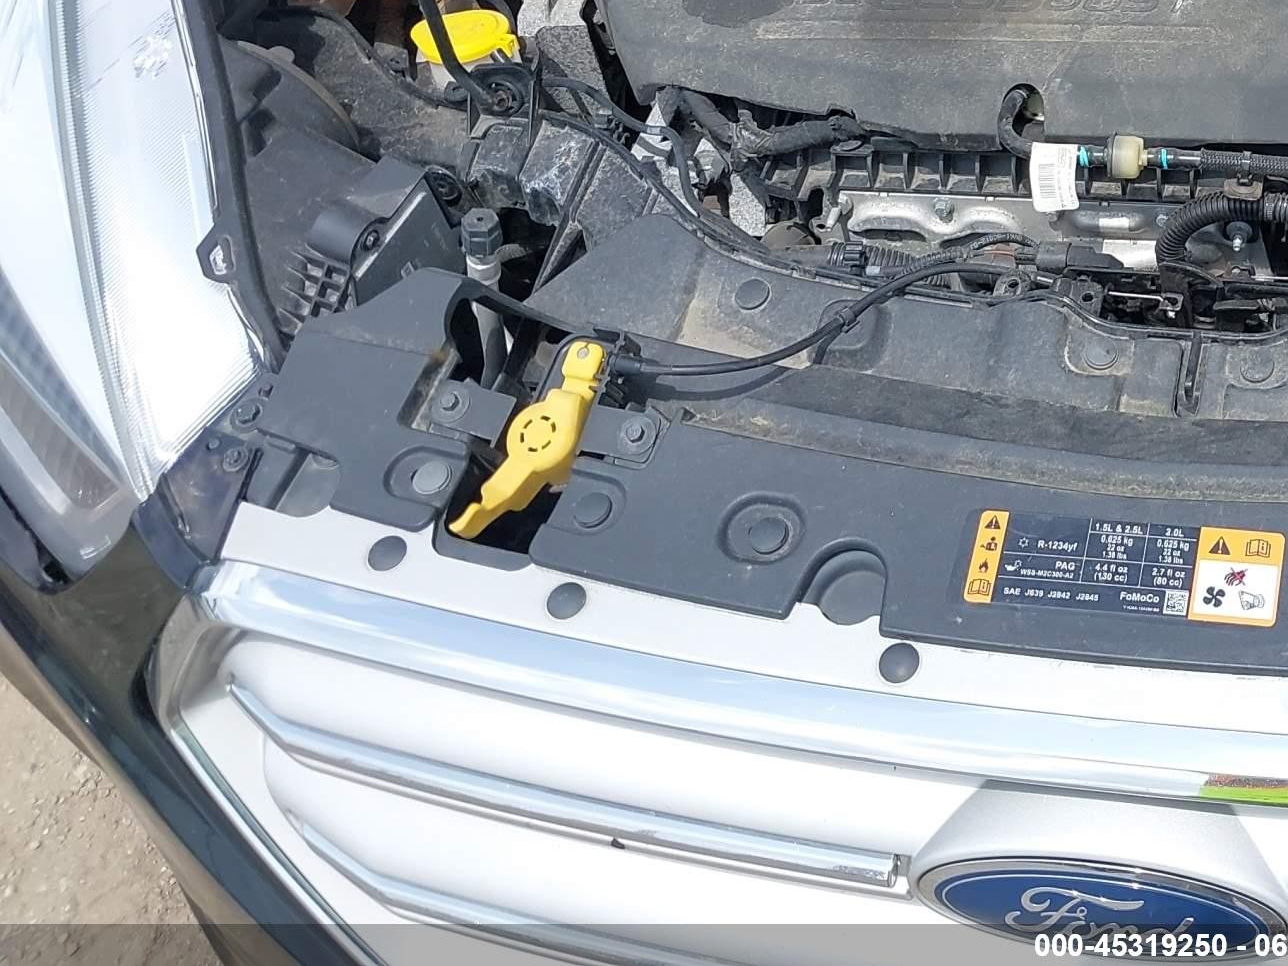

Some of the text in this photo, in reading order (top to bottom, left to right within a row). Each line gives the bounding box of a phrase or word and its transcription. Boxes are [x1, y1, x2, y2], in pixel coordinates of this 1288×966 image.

[1095, 523, 1143, 534] 1.5L & 2.5L
[1037, 540, 1078, 552] R-1234yf
[1123, 537, 1134, 546] kg
[1179, 541, 1190, 551] kg
[1116, 552, 1127, 560] lbs
[1055, 561, 1076, 571] PAG
[1095, 563, 1108, 571] 4.4
[1109, 564, 1116, 572] fl
[1152, 568, 1165, 576] 2.7
[1166, 569, 1173, 577] fl
[1114, 574, 1128, 583] cc)
[1153, 577, 1182, 588] (80 cc)
[1003, 587, 1099, 602] SAE J639 J2842 J2845
[1119, 591, 1160, 603] FoMoCo
